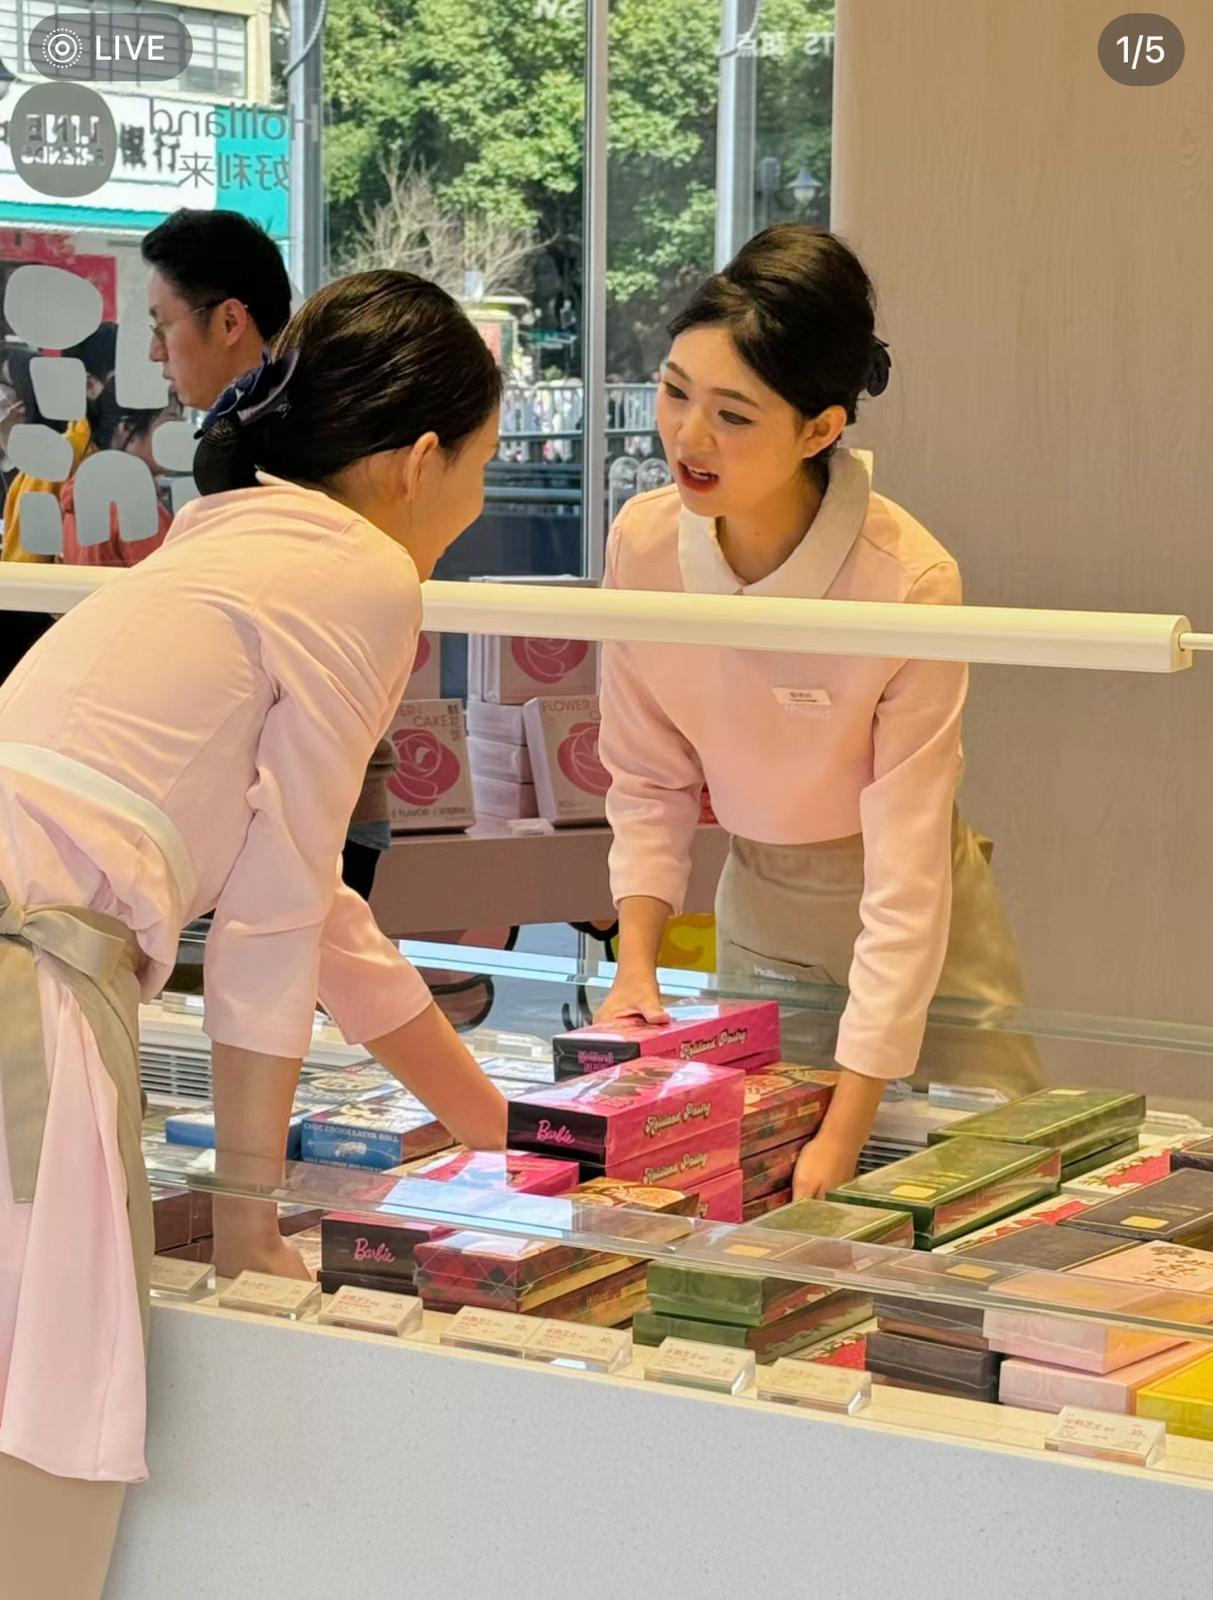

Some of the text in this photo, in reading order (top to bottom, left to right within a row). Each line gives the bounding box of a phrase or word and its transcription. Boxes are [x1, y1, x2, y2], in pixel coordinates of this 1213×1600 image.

[543, 700, 592, 712] FLOWER
[413, 714, 449, 727] CAKE
[536, 1119, 576, 1145] Barbie
[353, 1237, 396, 1264] Barbie
